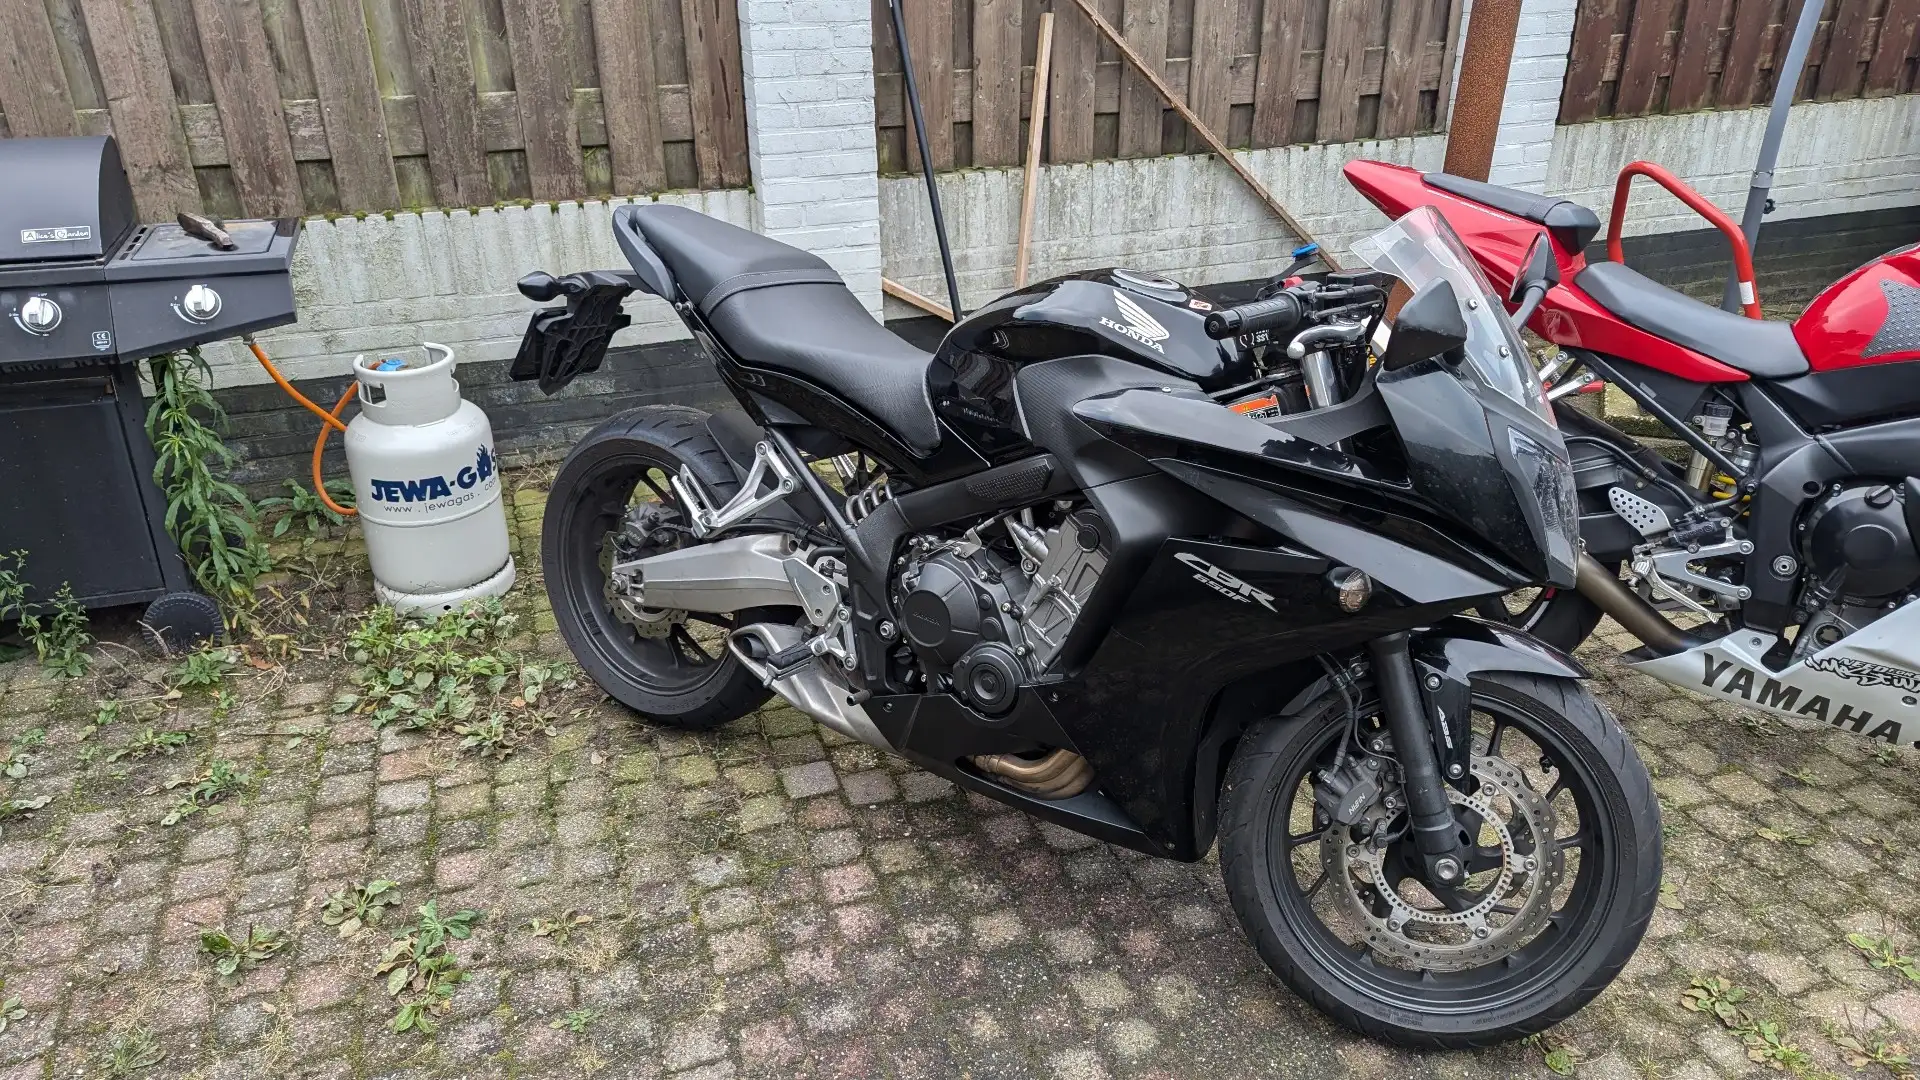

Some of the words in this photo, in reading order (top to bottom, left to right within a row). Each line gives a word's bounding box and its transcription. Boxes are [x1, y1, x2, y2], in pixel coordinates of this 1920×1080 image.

[1098, 316, 1165, 355] HONDA
[371, 445, 497, 503] JEWA-GAS
[1174, 552, 1278, 613] CBR
[1193, 573, 1252, 603] 650F
[1702, 652, 1902, 745] YAMAHA
[1436, 704, 1454, 749] ABS
